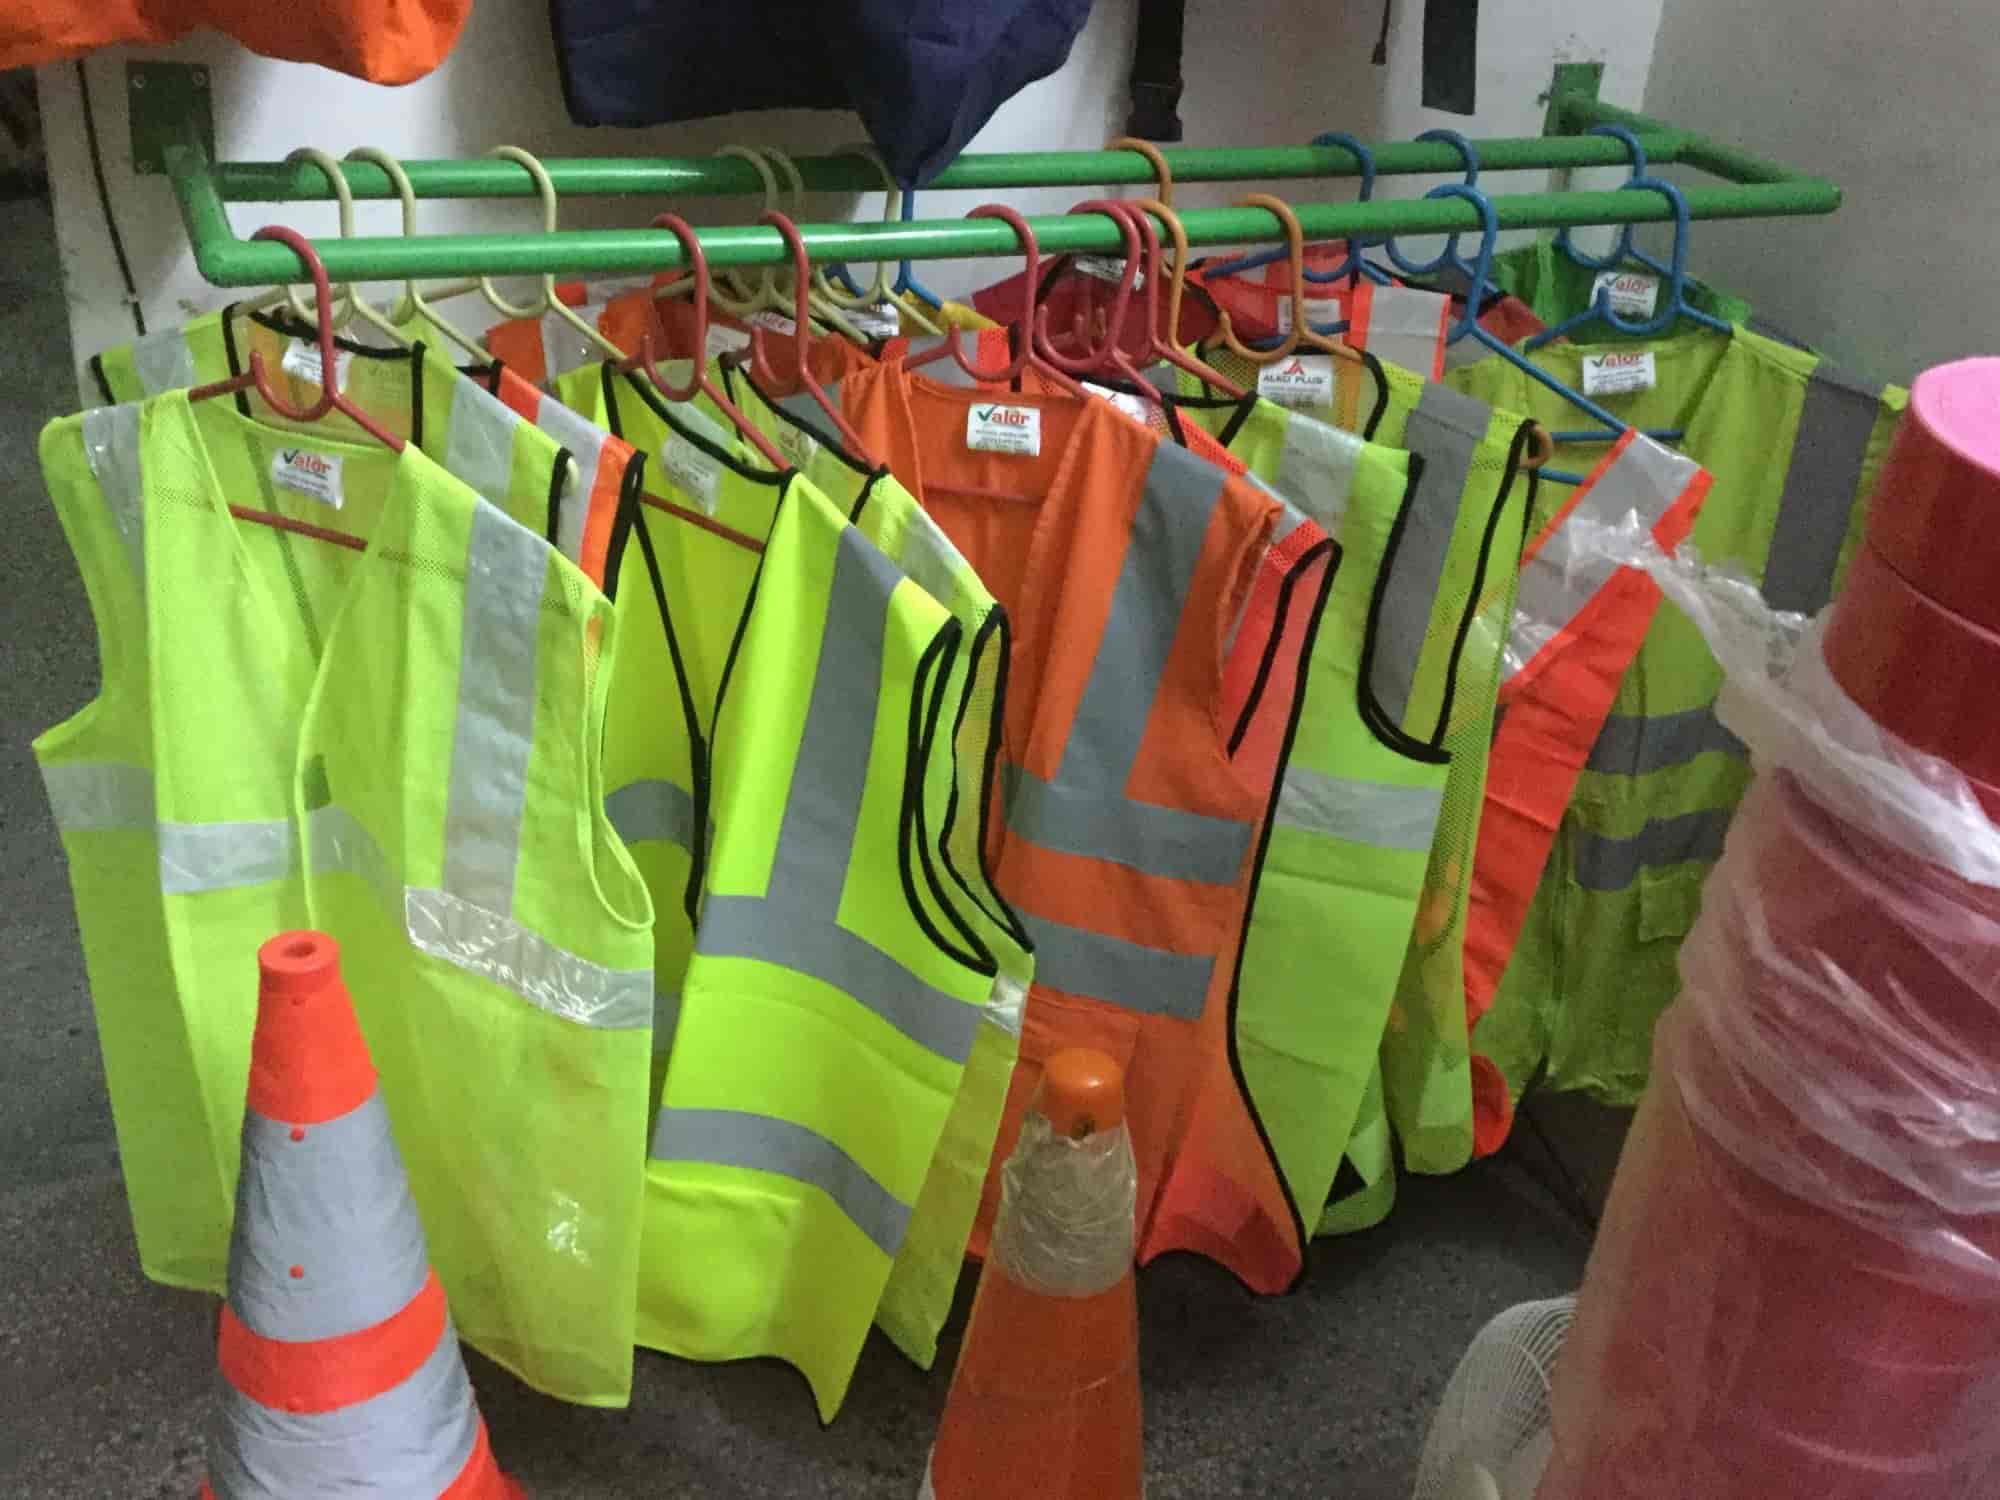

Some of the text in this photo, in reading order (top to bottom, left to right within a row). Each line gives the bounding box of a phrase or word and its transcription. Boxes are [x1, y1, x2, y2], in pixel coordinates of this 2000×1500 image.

[1592, 350, 1645, 368] Valor
[977, 404, 1030, 425] Valor
[283, 449, 332, 473] Valor
